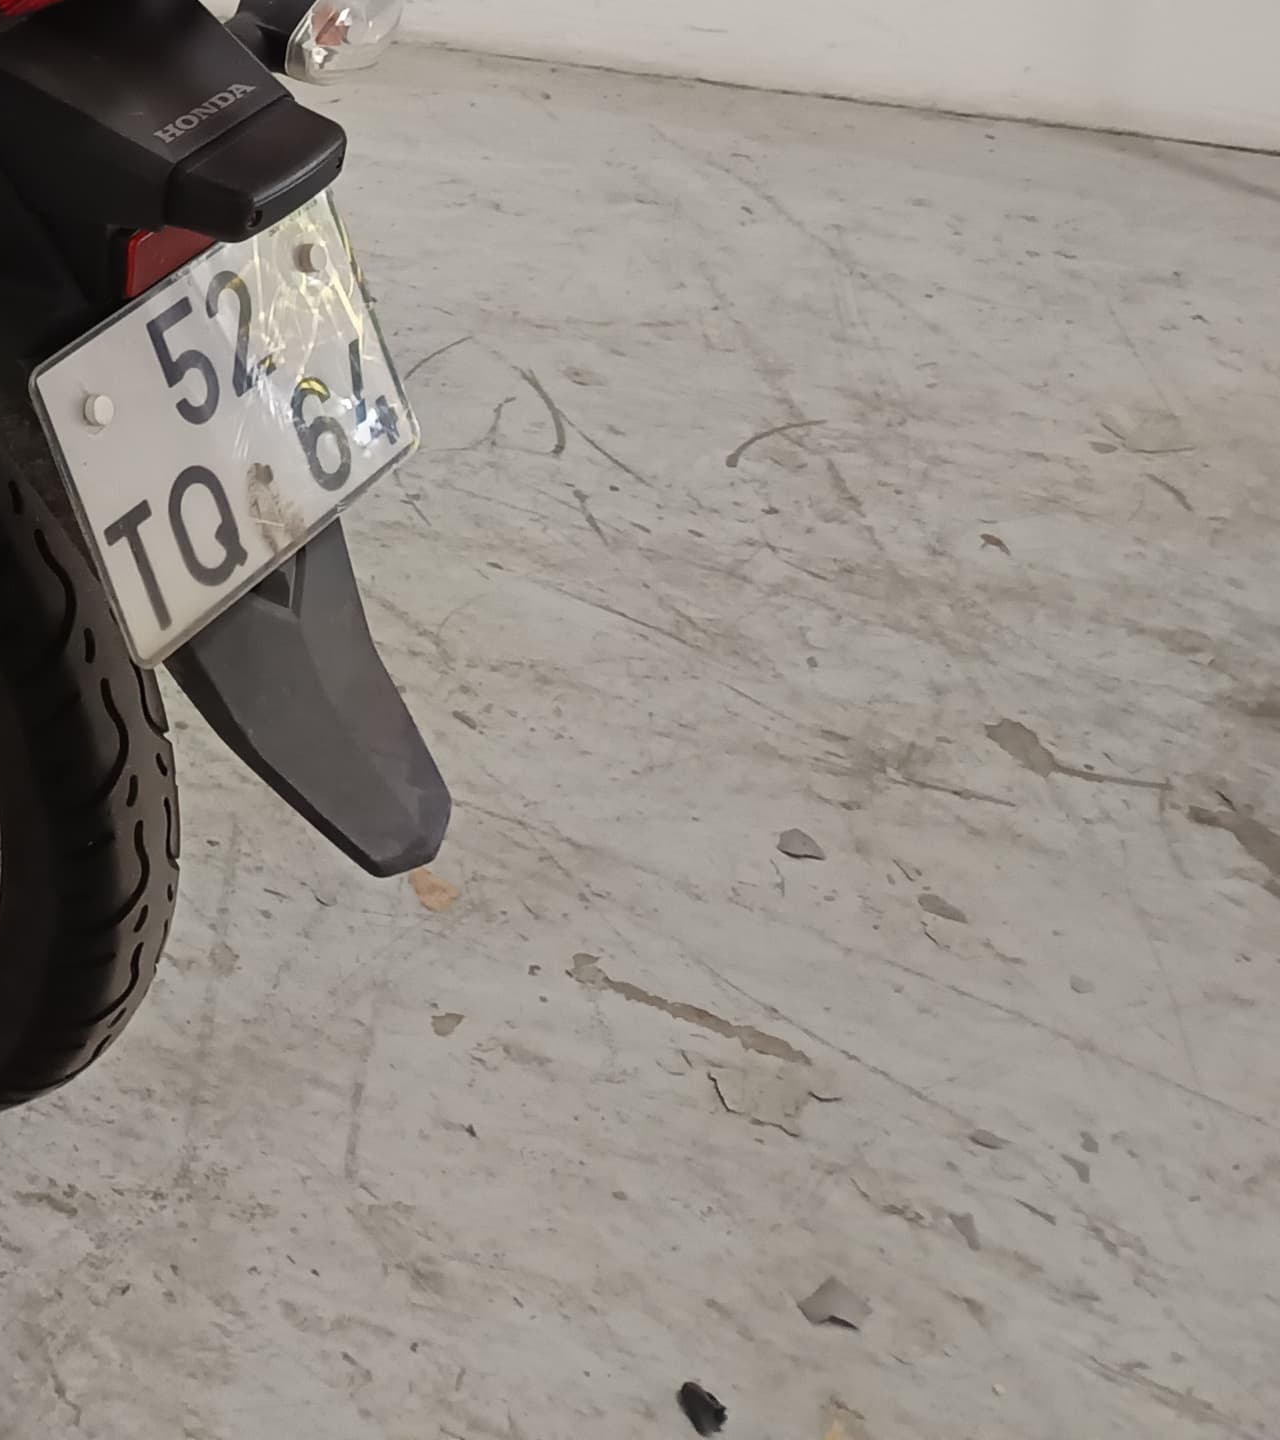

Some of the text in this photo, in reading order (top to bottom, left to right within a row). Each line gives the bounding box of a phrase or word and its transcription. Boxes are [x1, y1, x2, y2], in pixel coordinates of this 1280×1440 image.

[153, 81, 256, 144] HONDA
[146, 270, 277, 426] 52
[104, 465, 249, 631] TQ
